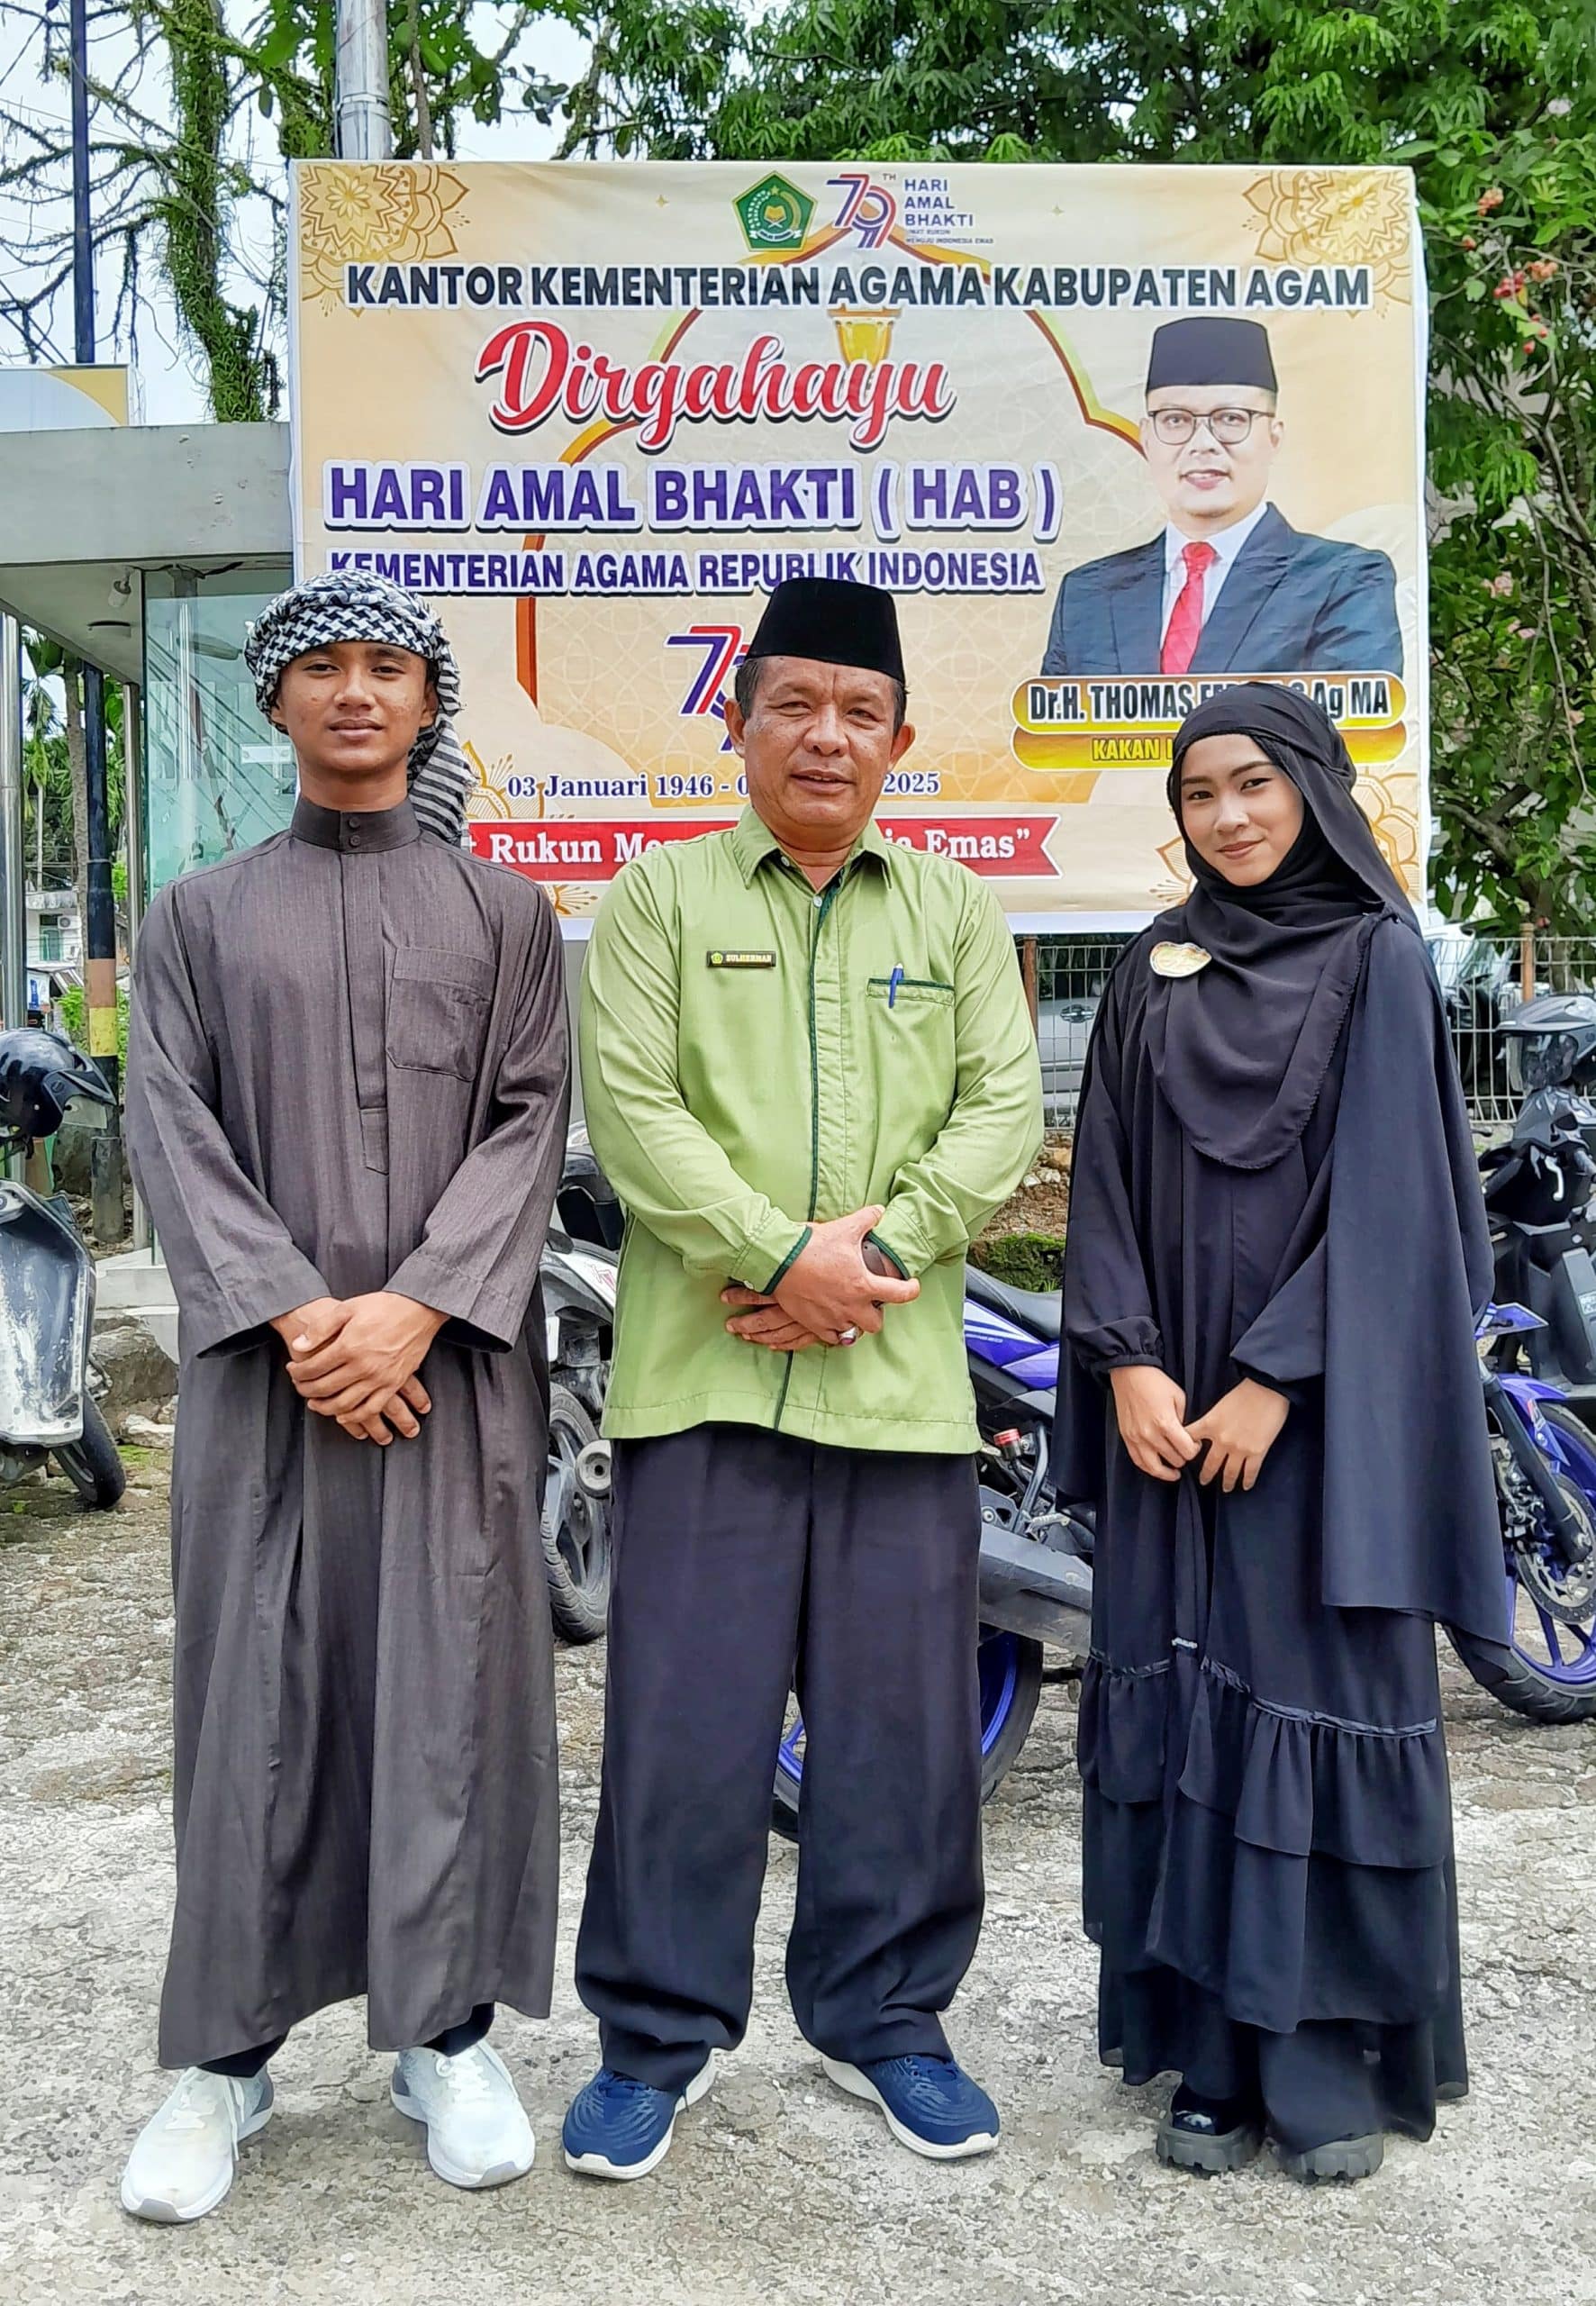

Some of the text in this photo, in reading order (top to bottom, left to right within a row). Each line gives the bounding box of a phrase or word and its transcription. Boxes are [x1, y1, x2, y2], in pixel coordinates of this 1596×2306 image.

[904, 179, 948, 192] HARI
[827, 174, 897, 249] 79
[904, 196, 955, 210] AMAL
[904, 213, 973, 227] BHAKTI
[348, 266, 1370, 306] KANTOR KEMENTERIAN AGAMA KABUPATEN AGAM
[476, 321, 957, 452] Dirgahayu
[331, 468, 463, 520] HARI
[483, 469, 636, 522] AMAL
[654, 468, 855, 522] BHAKTI
[575, 555, 689, 588] AGAMA
[699, 552, 857, 586] REPUBLIK
[868, 552, 1040, 586] INDONESIA
[1091, 683, 1192, 720] THOMAS
[1353, 680, 1389, 714] MA
[1093, 738, 1159, 761] KAKAN
[507, 776, 535, 797] 03
[544, 774, 647, 797] Januari
[657, 776, 712, 796] 1946
[884, 773, 939, 793] 2025
[490, 832, 602, 863] Rukun
